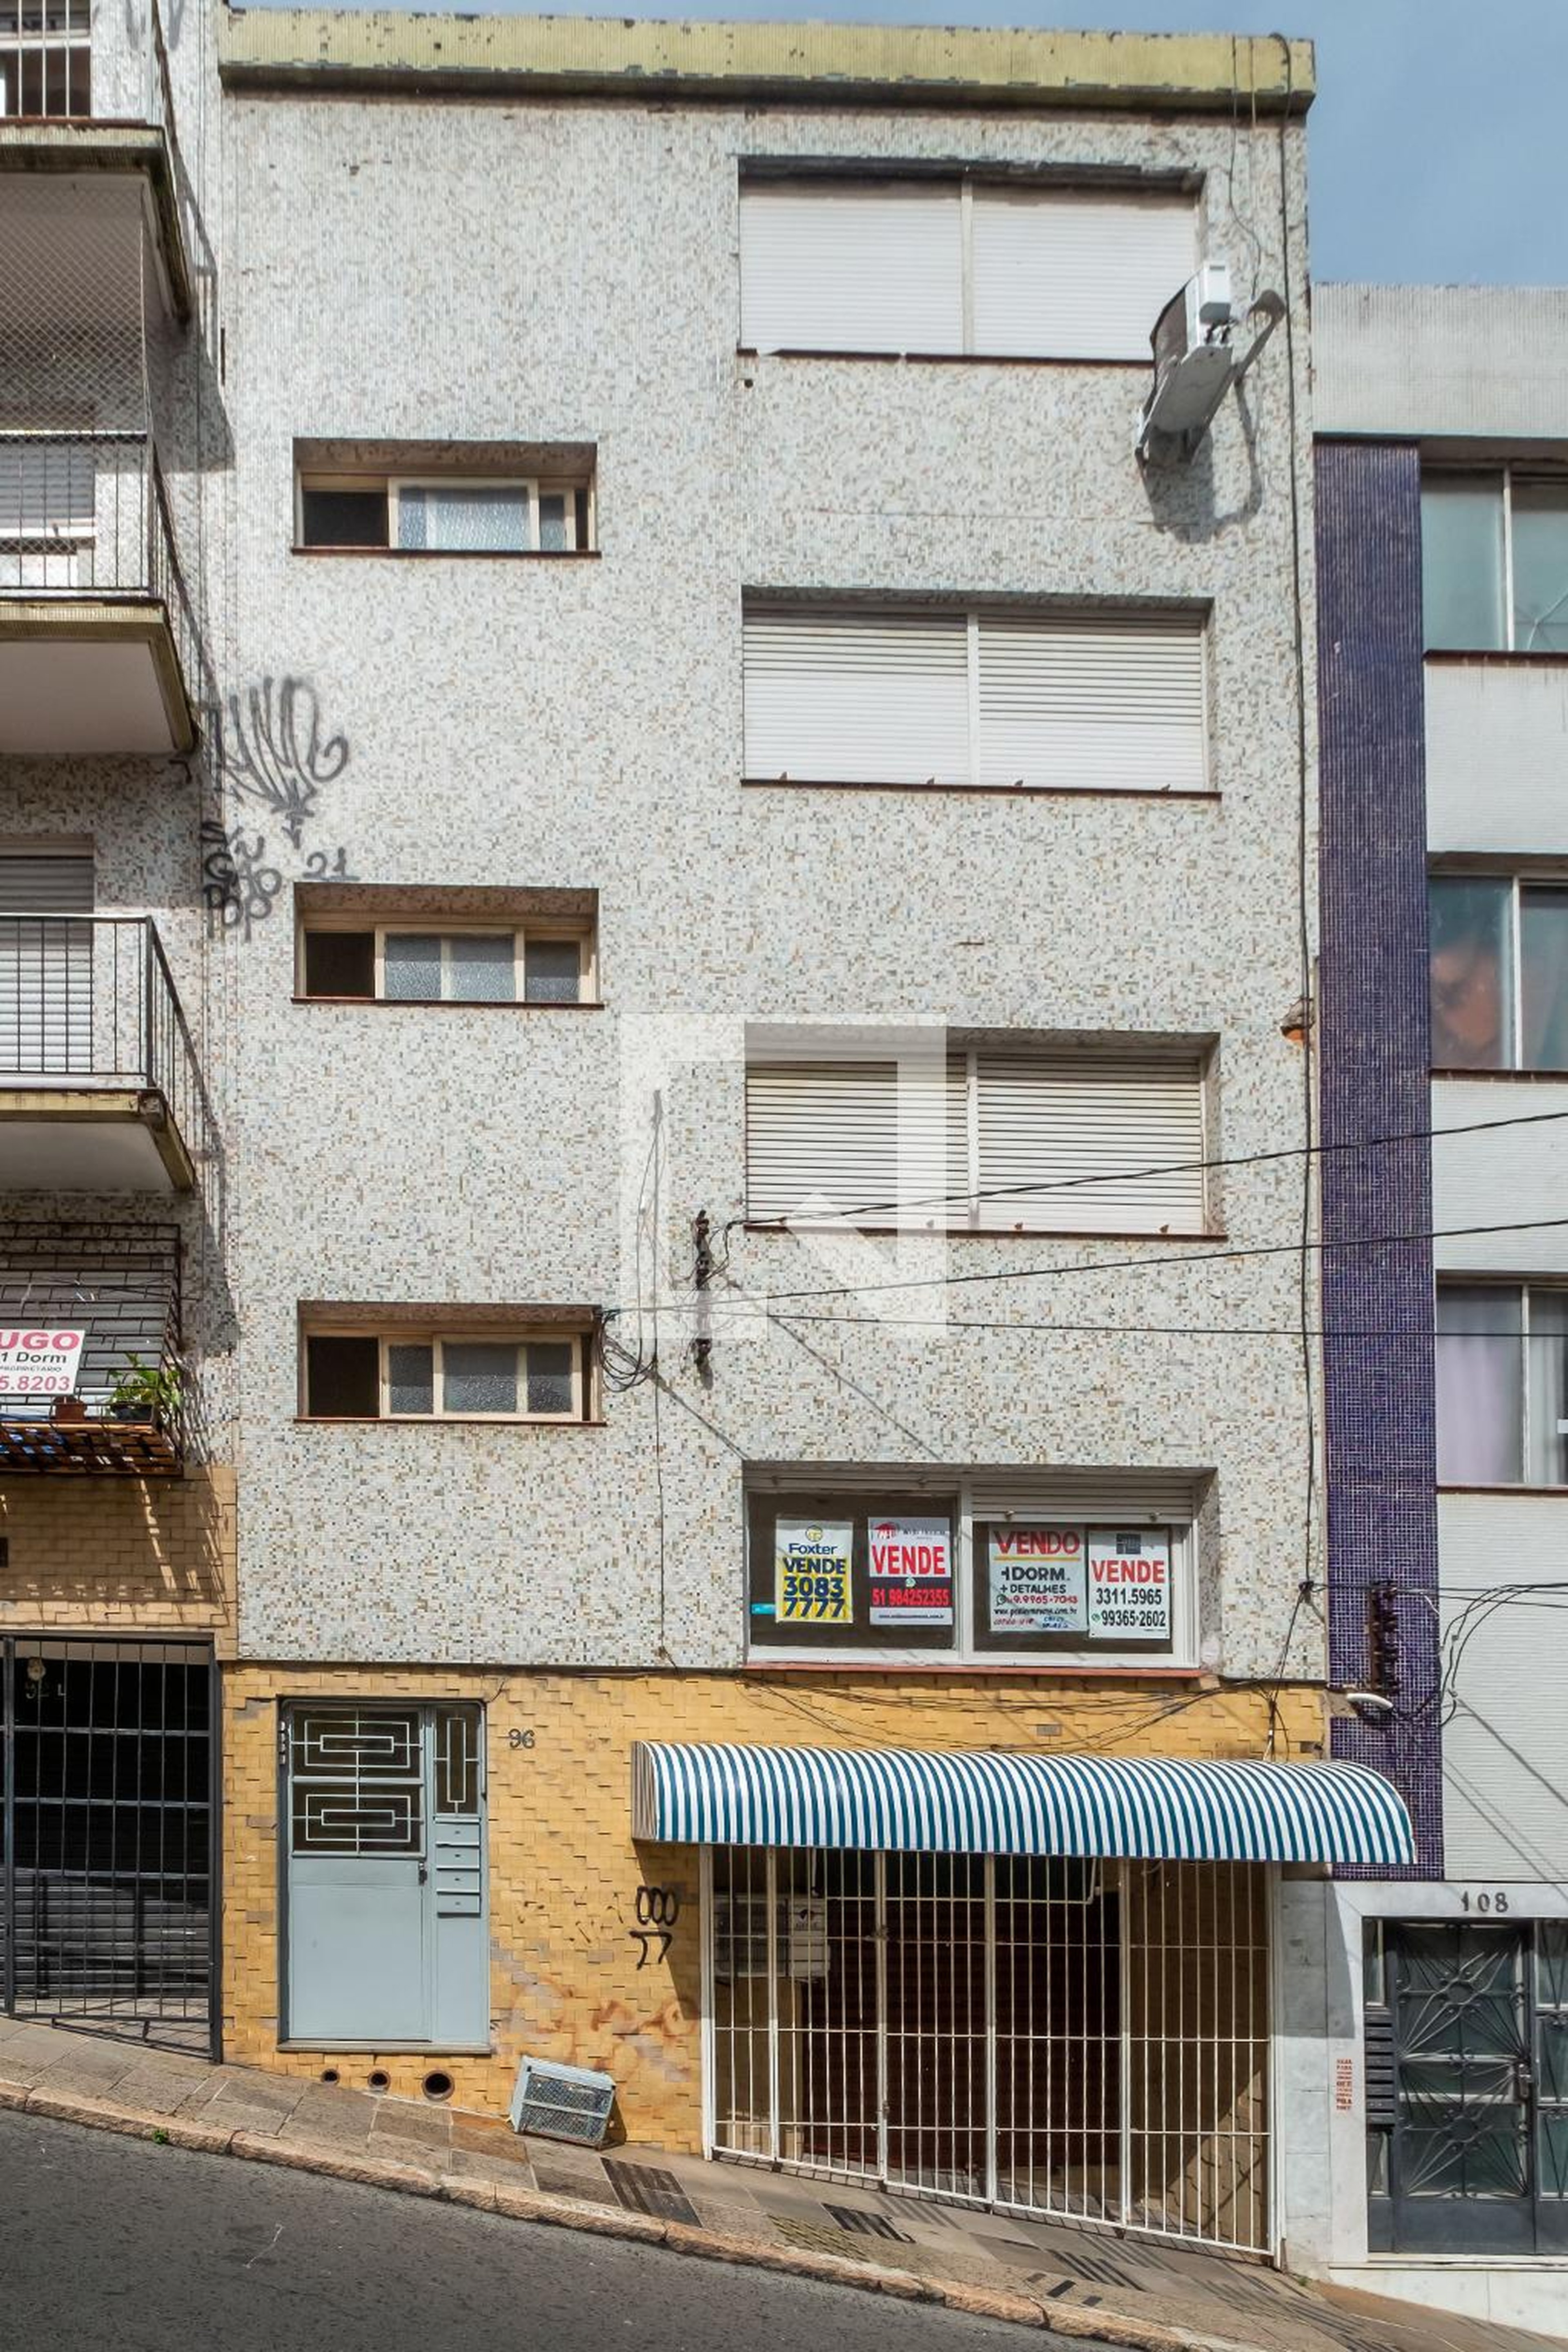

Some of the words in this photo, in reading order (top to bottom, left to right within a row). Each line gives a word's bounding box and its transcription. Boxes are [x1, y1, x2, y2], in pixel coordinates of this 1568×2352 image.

[16, 1352, 67, 1363] Dorm
[788, 1543, 837, 1555] Foxter
[993, 1530, 1080, 1554] VENDO
[783, 1557, 846, 1574] VENDE
[872, 1545, 945, 1575] VENDE
[1091, 1560, 1165, 1583] VENDE
[784, 1576, 844, 1597] 3083
[1010, 1584, 1066, 1593] DETALHES
[873, 1588, 885, 1606] 51
[1096, 1588, 1162, 1605] 3311.5965
[783, 1597, 845, 1617] 7777
[1461, 1891, 1509, 1913] 108
